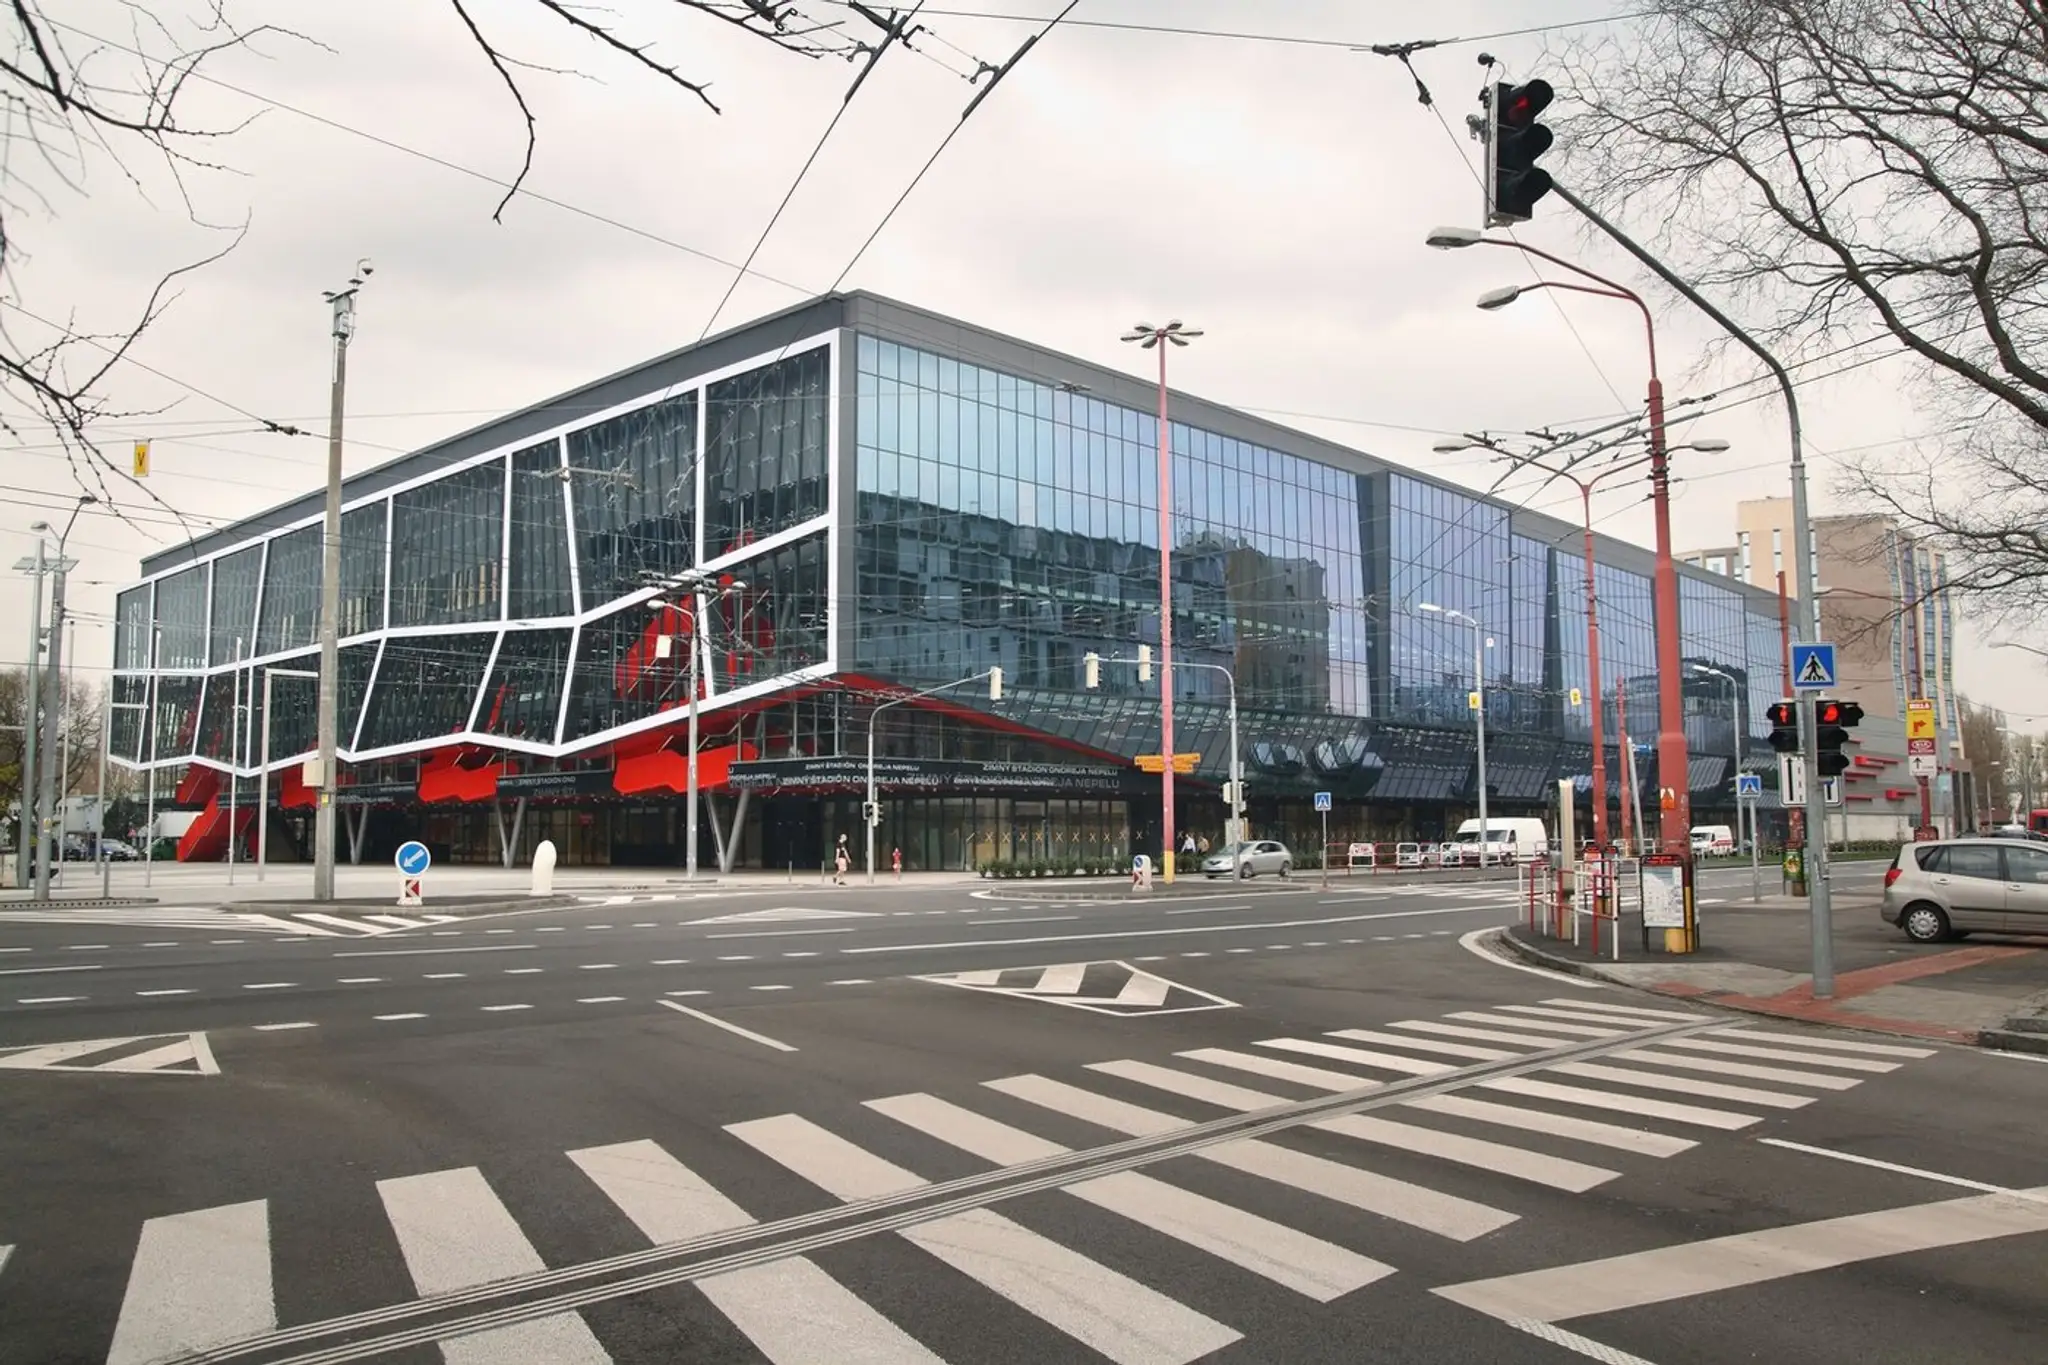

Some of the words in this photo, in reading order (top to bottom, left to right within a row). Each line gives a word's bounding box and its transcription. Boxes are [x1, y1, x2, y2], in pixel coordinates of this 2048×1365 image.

[857, 762, 891, 770] ONREJA
[852, 774, 901, 786] ONREJA
[1075, 778, 1121, 789] NEPELU
